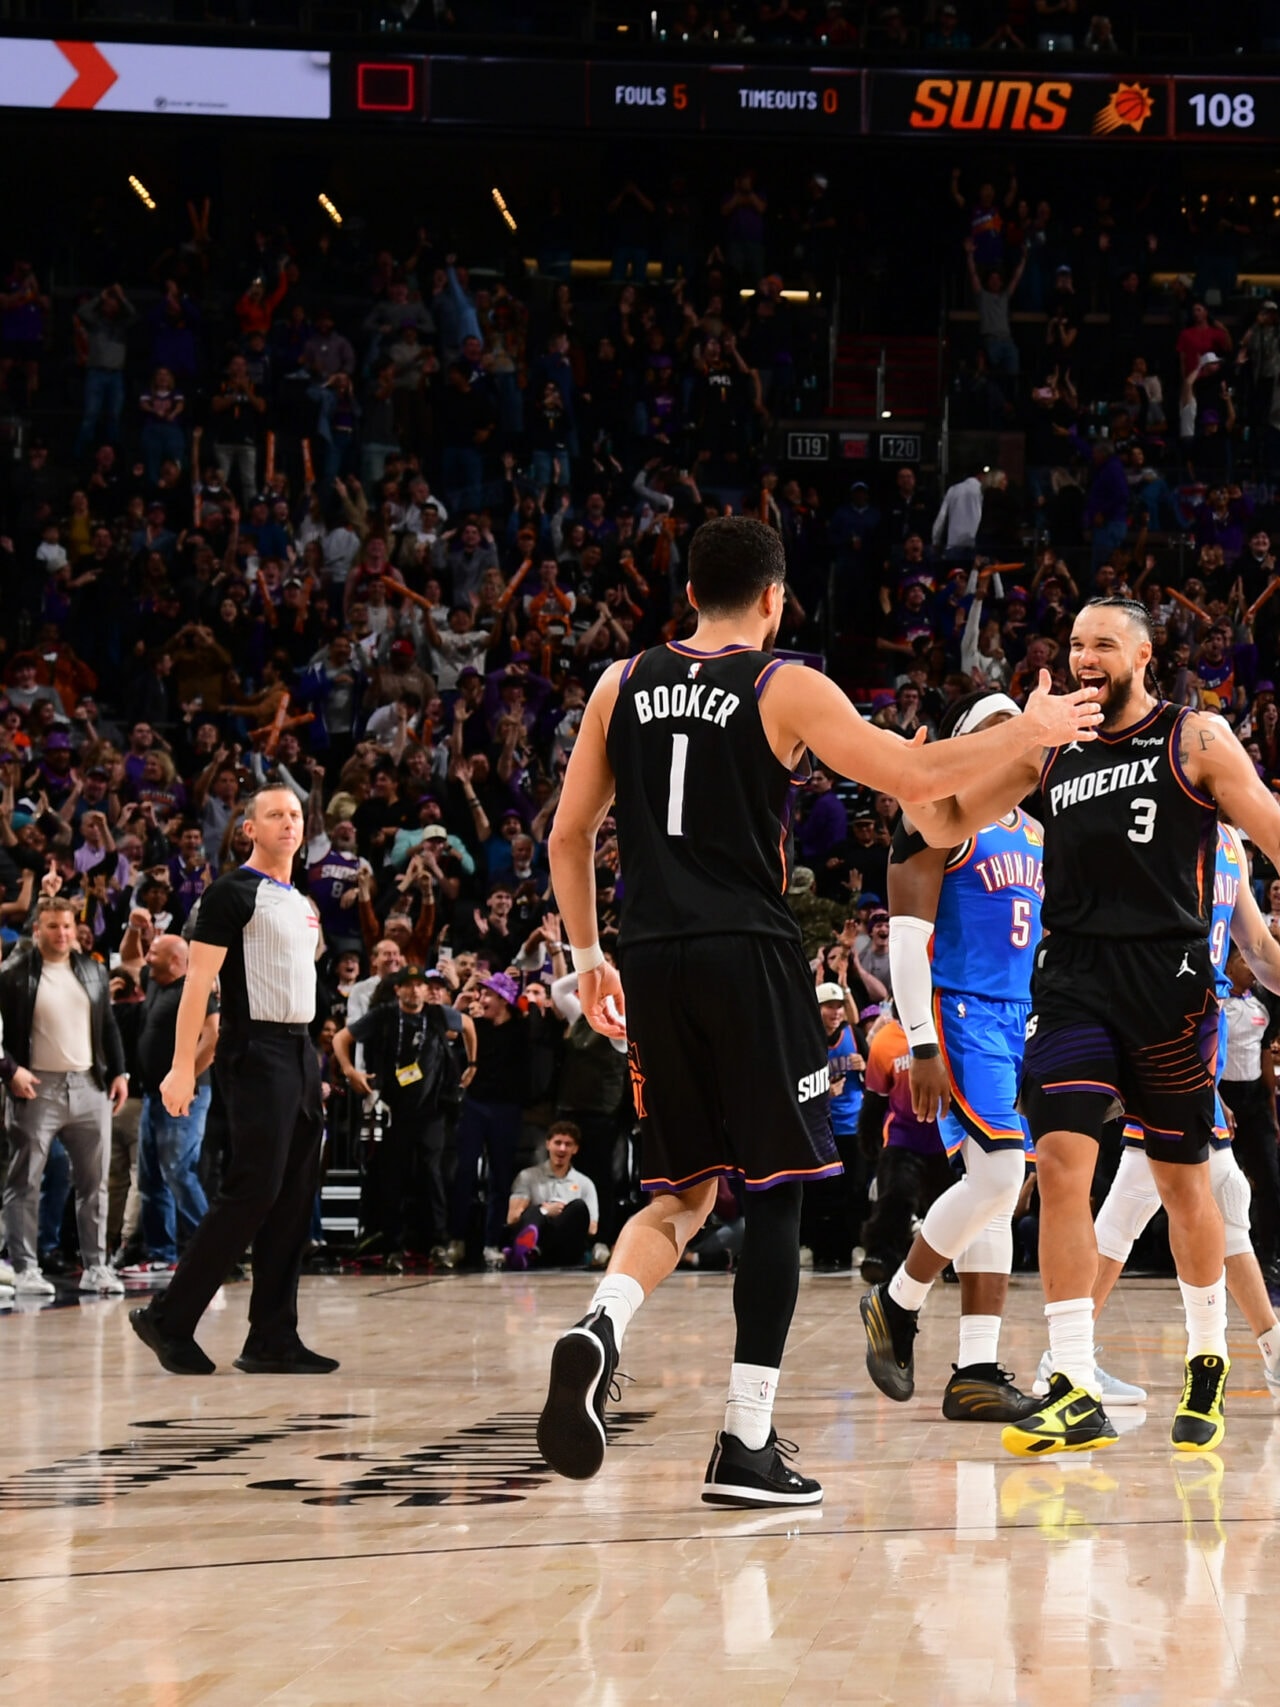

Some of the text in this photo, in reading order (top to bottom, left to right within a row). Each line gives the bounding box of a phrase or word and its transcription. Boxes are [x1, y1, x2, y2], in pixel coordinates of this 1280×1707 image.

[614, 84, 688, 110] FOULS 5
[738, 87, 838, 114] TIMEOUTS 0
[909, 79, 1073, 131] SUNS
[1187, 93, 1256, 128] 108
[796, 437, 822, 456] 119
[887, 439, 915, 457] 120
[633, 683, 741, 729] BOOKER
[1131, 736, 1164, 748] PayPal
[667, 733, 690, 836] 1
[1050, 755, 1160, 817] PHOENIX
[1127, 797, 1158, 844] 3
[974, 852, 1045, 900] THUNDE
[1010, 898, 1032, 949] 5
[1209, 920, 1226, 966] 9
